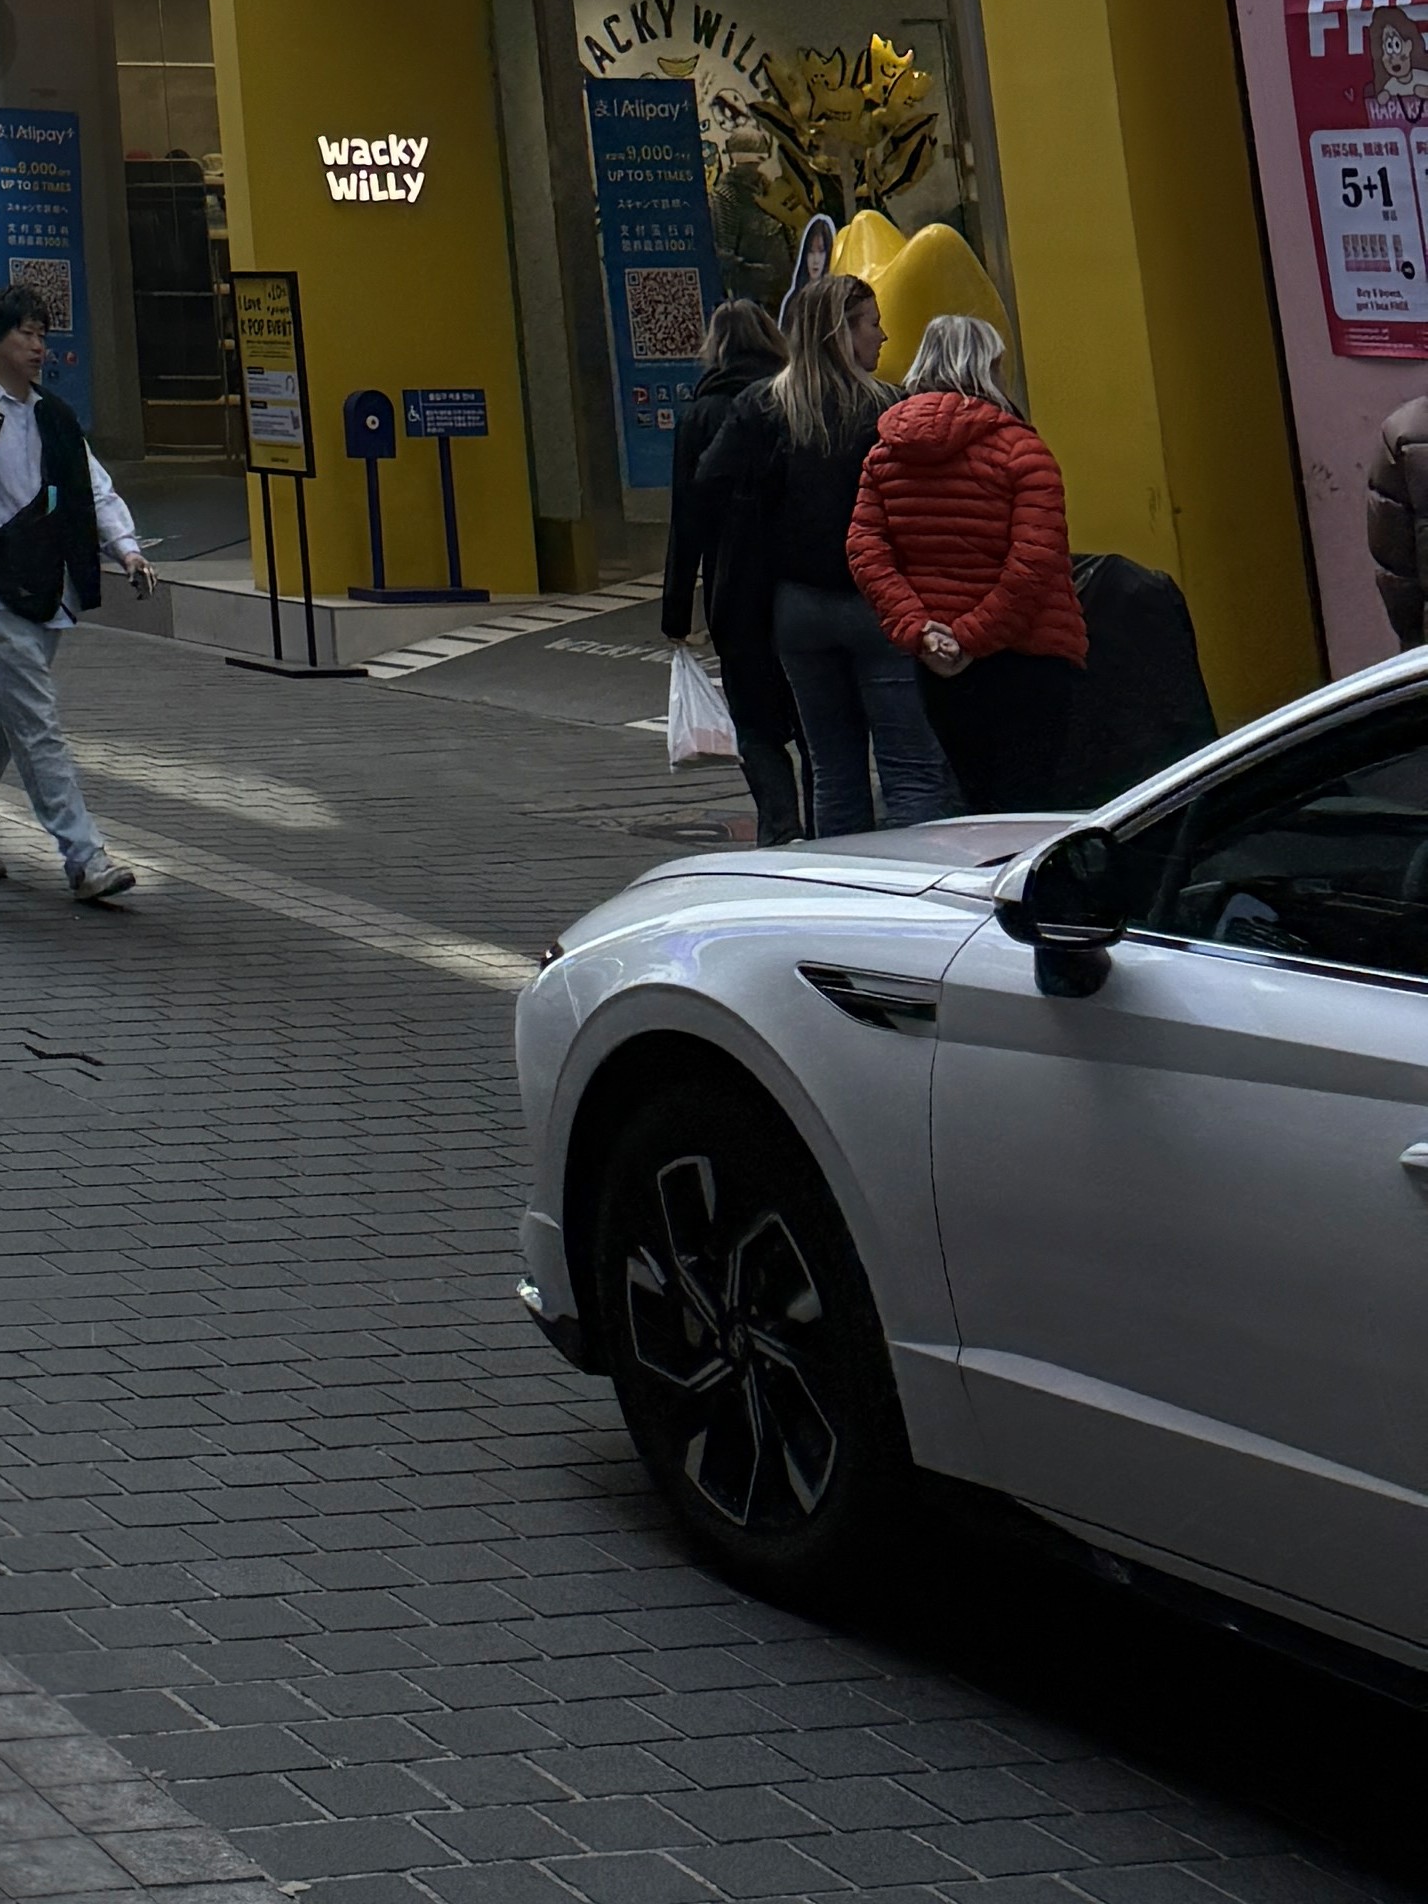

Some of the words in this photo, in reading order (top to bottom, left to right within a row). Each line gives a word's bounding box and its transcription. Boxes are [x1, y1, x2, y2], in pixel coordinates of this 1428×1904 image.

[607, 169, 624, 182] UP
[625, 169, 644, 182] TO
[656, 169, 694, 182] TIMES
[0, 179, 15, 190] UP
[17, 179, 32, 191] TO
[1341, 166, 1395, 208] 5+1
[266, 319, 293, 337] EVENT
